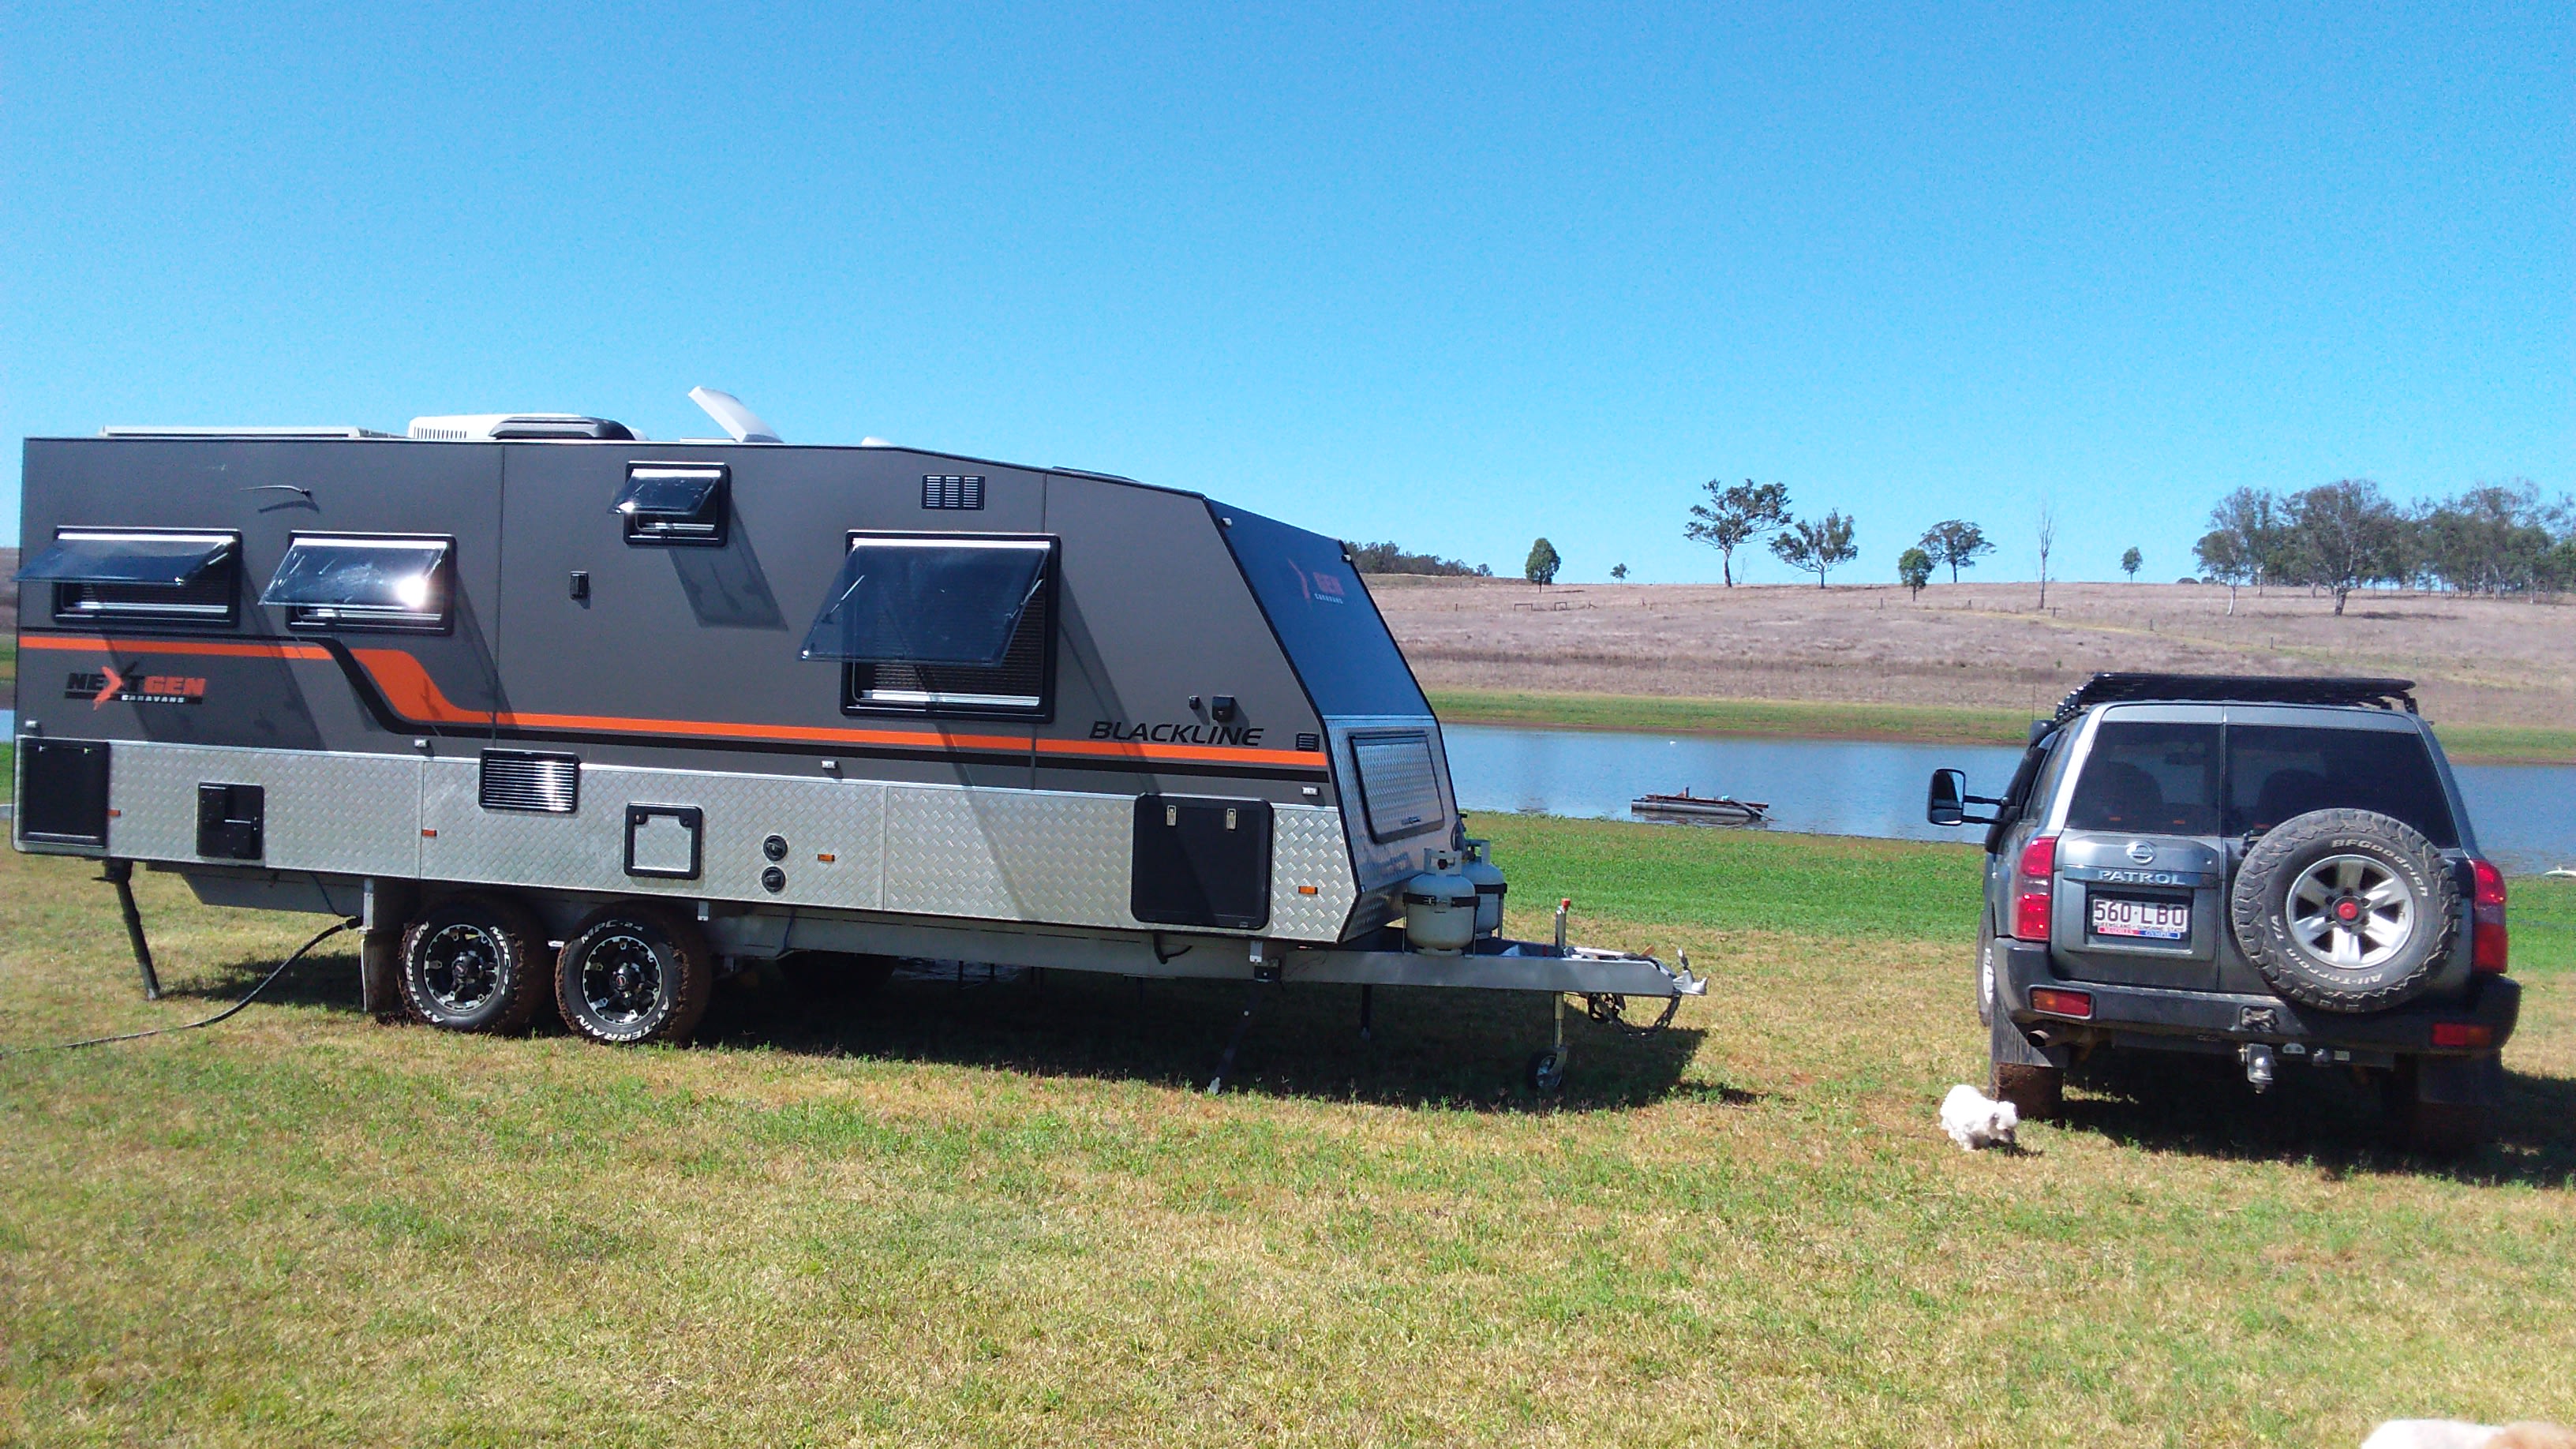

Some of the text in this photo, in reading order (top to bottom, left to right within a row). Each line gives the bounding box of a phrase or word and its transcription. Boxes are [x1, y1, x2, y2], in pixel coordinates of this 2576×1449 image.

[121, 694, 185, 704] CARAVANS
[1088, 720, 1264, 747] BLACKLINE
[2097, 870, 2186, 886] PATROL
